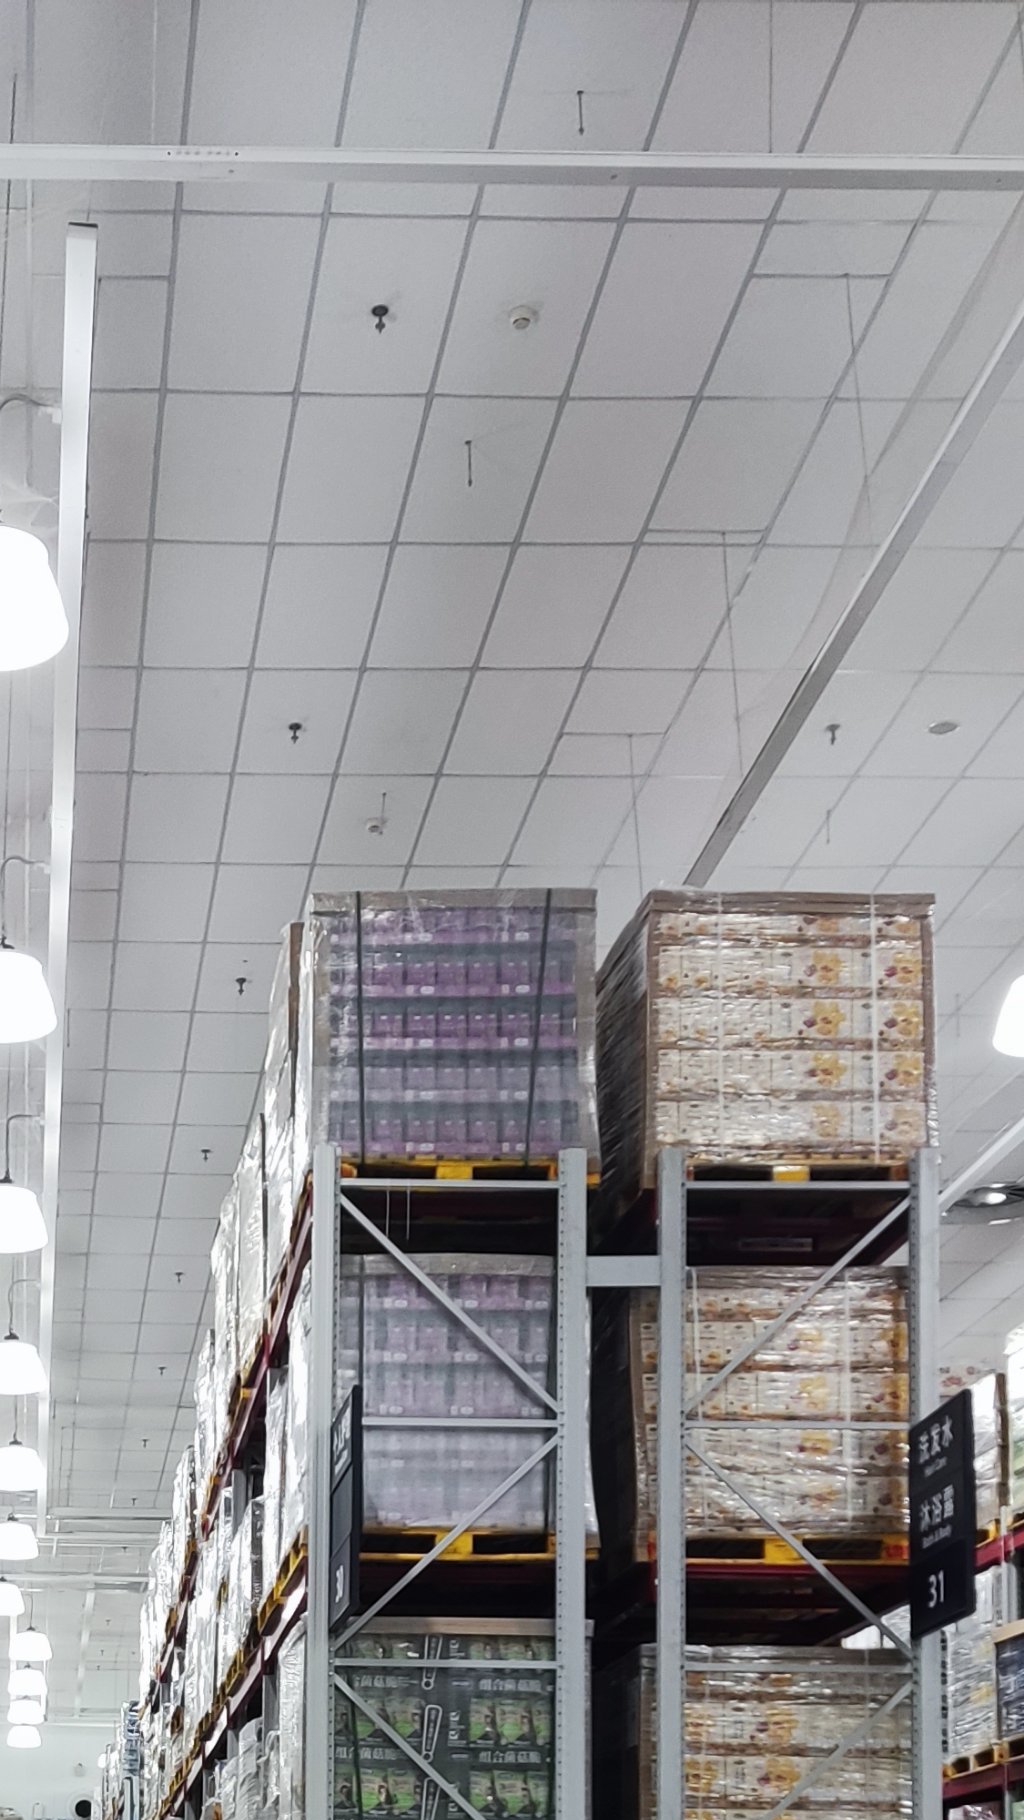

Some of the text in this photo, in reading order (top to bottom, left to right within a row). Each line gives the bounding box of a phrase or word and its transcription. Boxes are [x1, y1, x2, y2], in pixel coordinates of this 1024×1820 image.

[918, 1415, 954, 1465] 洗发水
[919, 1484, 954, 1533] 沐浴露
[928, 1569, 944, 1609] 31
